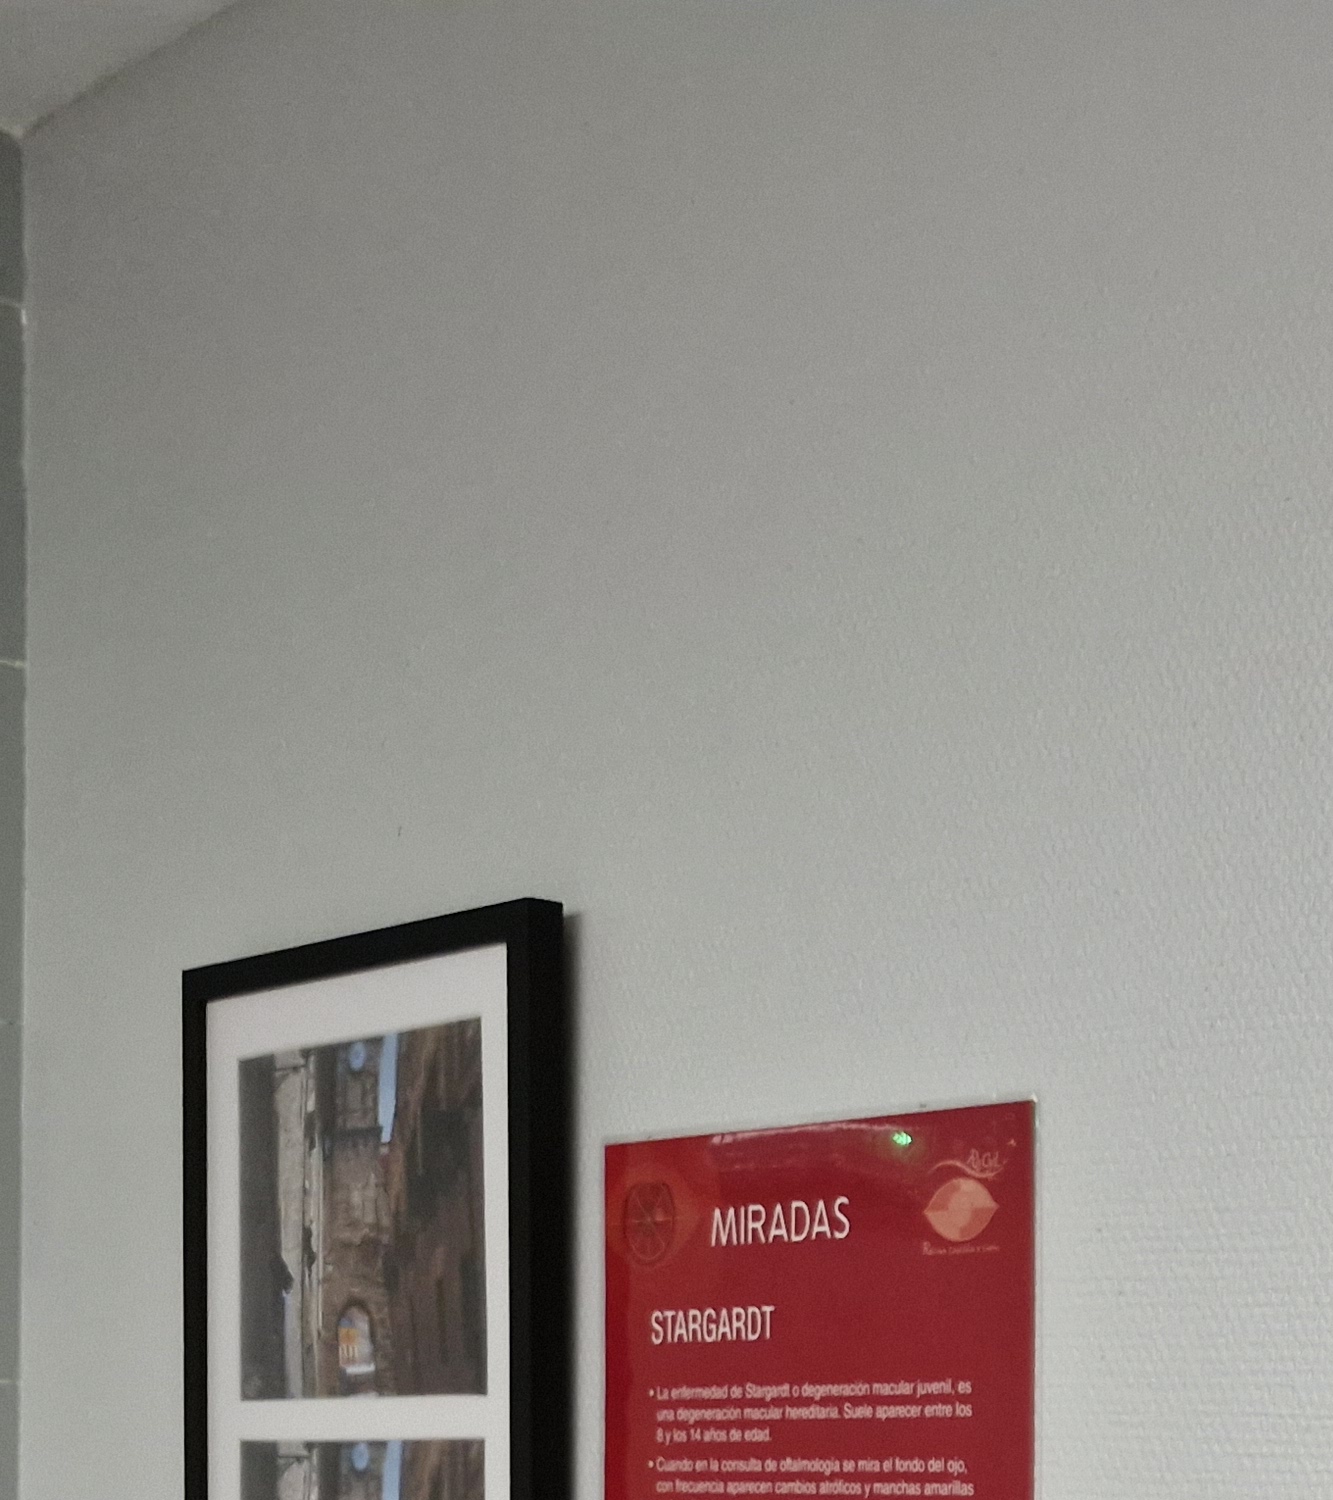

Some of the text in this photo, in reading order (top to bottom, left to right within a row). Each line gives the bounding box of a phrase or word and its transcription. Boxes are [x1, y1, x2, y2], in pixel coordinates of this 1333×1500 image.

[710, 1196, 851, 1247] MIRADAS
[650, 1305, 775, 1345] STARGARDT
[872, 1379, 915, 1396] macular
[917, 1377, 957, 1398] juvenil,
[957, 1380, 972, 1394] es
[843, 1401, 873, 1419] Suele
[875, 1404, 922, 1421] aparecer
[924, 1402, 953, 1417] entre
[955, 1401, 972, 1417] los
